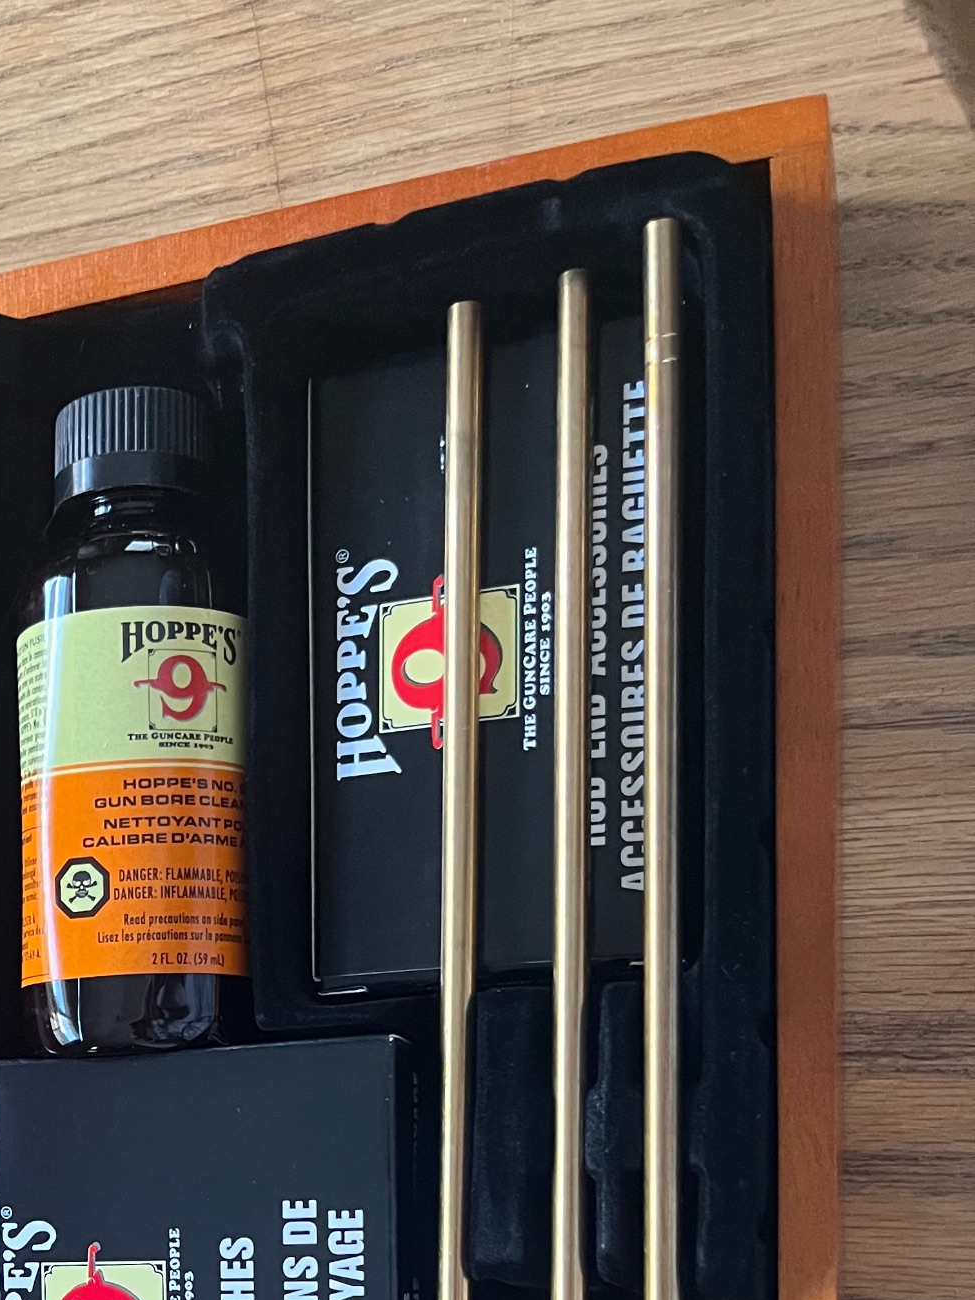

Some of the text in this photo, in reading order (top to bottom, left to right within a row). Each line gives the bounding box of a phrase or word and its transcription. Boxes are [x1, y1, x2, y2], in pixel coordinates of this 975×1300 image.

[523, 547, 536, 750] THE GUNCARE PEOPLE
[539, 592, 551, 695] SINCE 1903
[128, 732, 234, 745] THE GUNCARE PEOPLE
[123, 778, 208, 789] HOPPE'S
[212, 780, 237, 793] NO.
[94, 796, 137, 808] GUN
[141, 795, 196, 805] BORE
[104, 816, 221, 829] NETTOYANT
[83, 834, 167, 847] CALIBRE
[172, 833, 237, 846] D'ARME
[119, 868, 162, 882] DANGER:
[166, 868, 223, 884] FLAMMABLE,
[114, 888, 157, 900] DANGER:
[161, 886, 227, 903] INFLAMMABLE,
[124, 913, 145, 925] Read
[149, 913, 199, 929] precautions
[202, 916, 211, 925] on
[214, 912, 227, 926] side
[98, 932, 118, 943] Lisez
[121, 930, 134, 941] les
[137, 929, 188, 943] précautions
[191, 932, 203, 941] sur
[206, 929, 212, 941] le
[152, 953, 157, 964] 2
[161, 953, 174, 965] FL.
[177, 953, 191, 965] OZ.
[194, 953, 208, 965] (59
[282, 1200, 318, 1245] DE
[168, 1228, 181, 1291] PEOPLE
